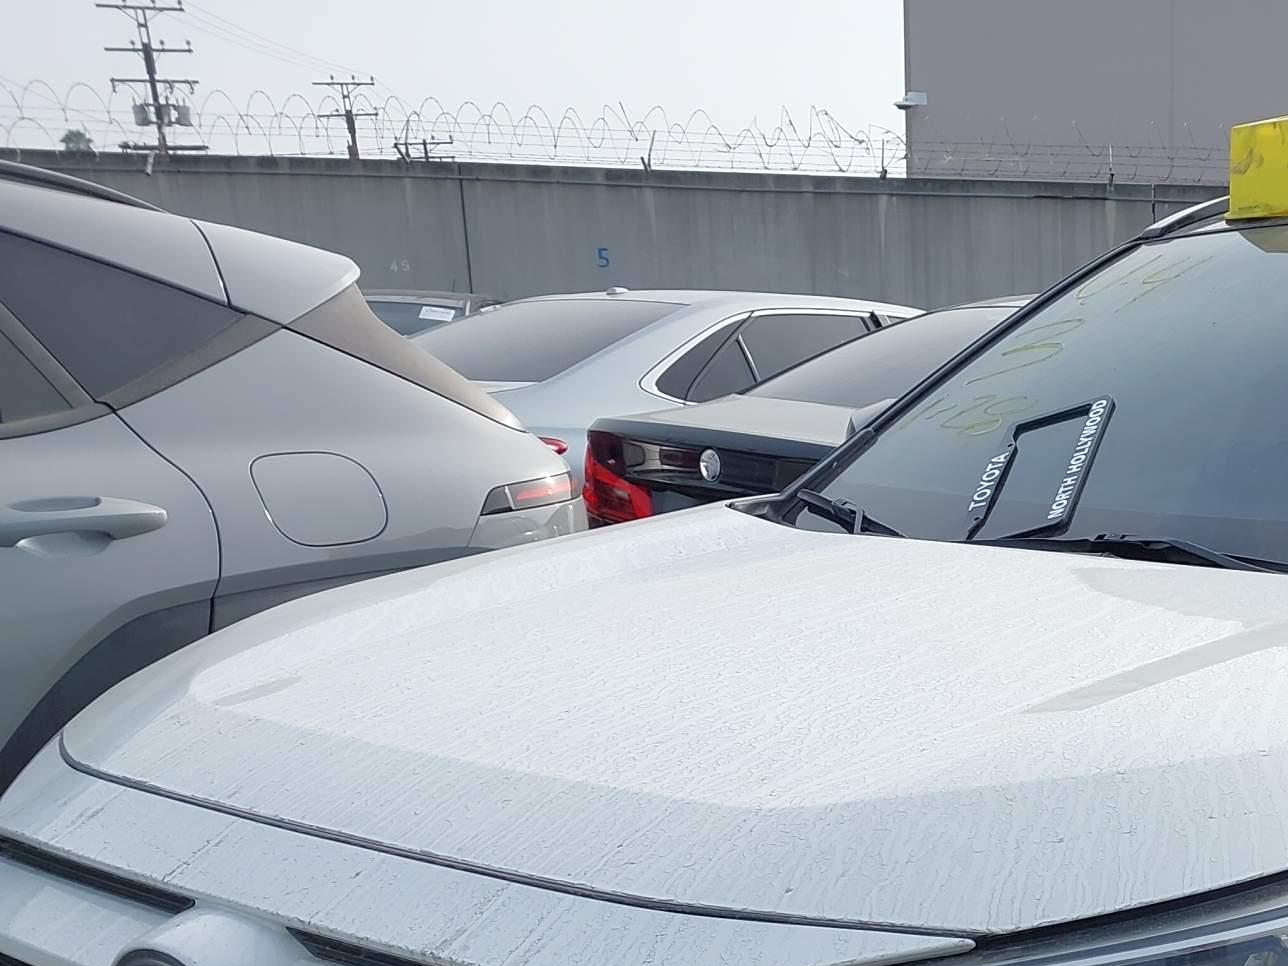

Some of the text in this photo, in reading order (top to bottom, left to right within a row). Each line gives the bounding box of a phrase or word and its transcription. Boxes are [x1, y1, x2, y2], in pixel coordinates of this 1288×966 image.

[597, 247, 610, 268] 5
[968, 451, 1009, 512] TOYOTA
[1047, 399, 1107, 519] NORTH HOLLYWOOD
